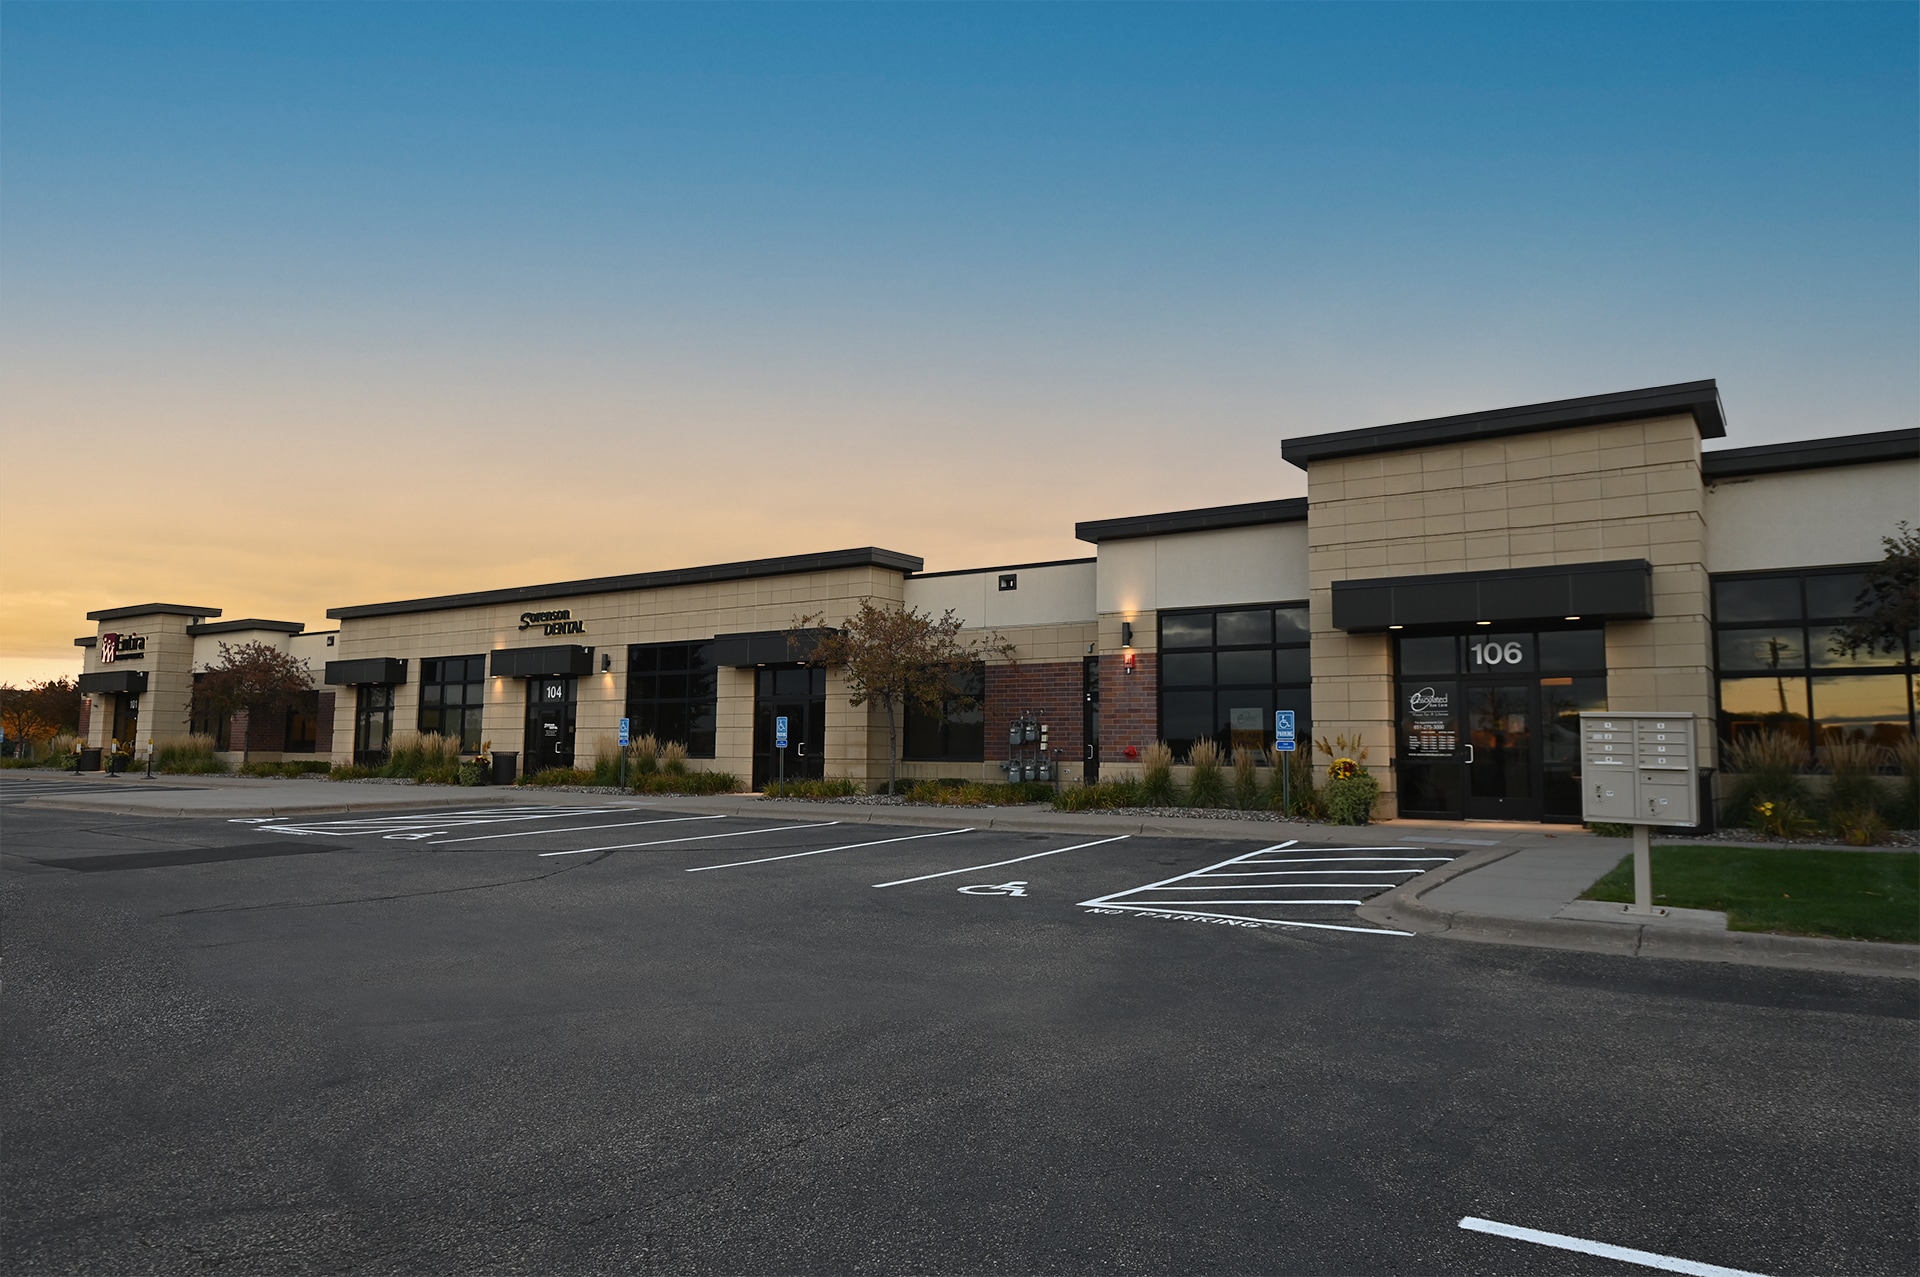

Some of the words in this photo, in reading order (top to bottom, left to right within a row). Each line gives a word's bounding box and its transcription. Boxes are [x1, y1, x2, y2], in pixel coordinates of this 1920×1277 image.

[518, 610, 571, 630] Sorenson
[544, 620, 586, 636] DENTAL
[1471, 641, 1523, 665] 106
[546, 685, 562, 699] 104
[1084, 907, 1124, 915] NO
[1134, 911, 1263, 929] PARKING
